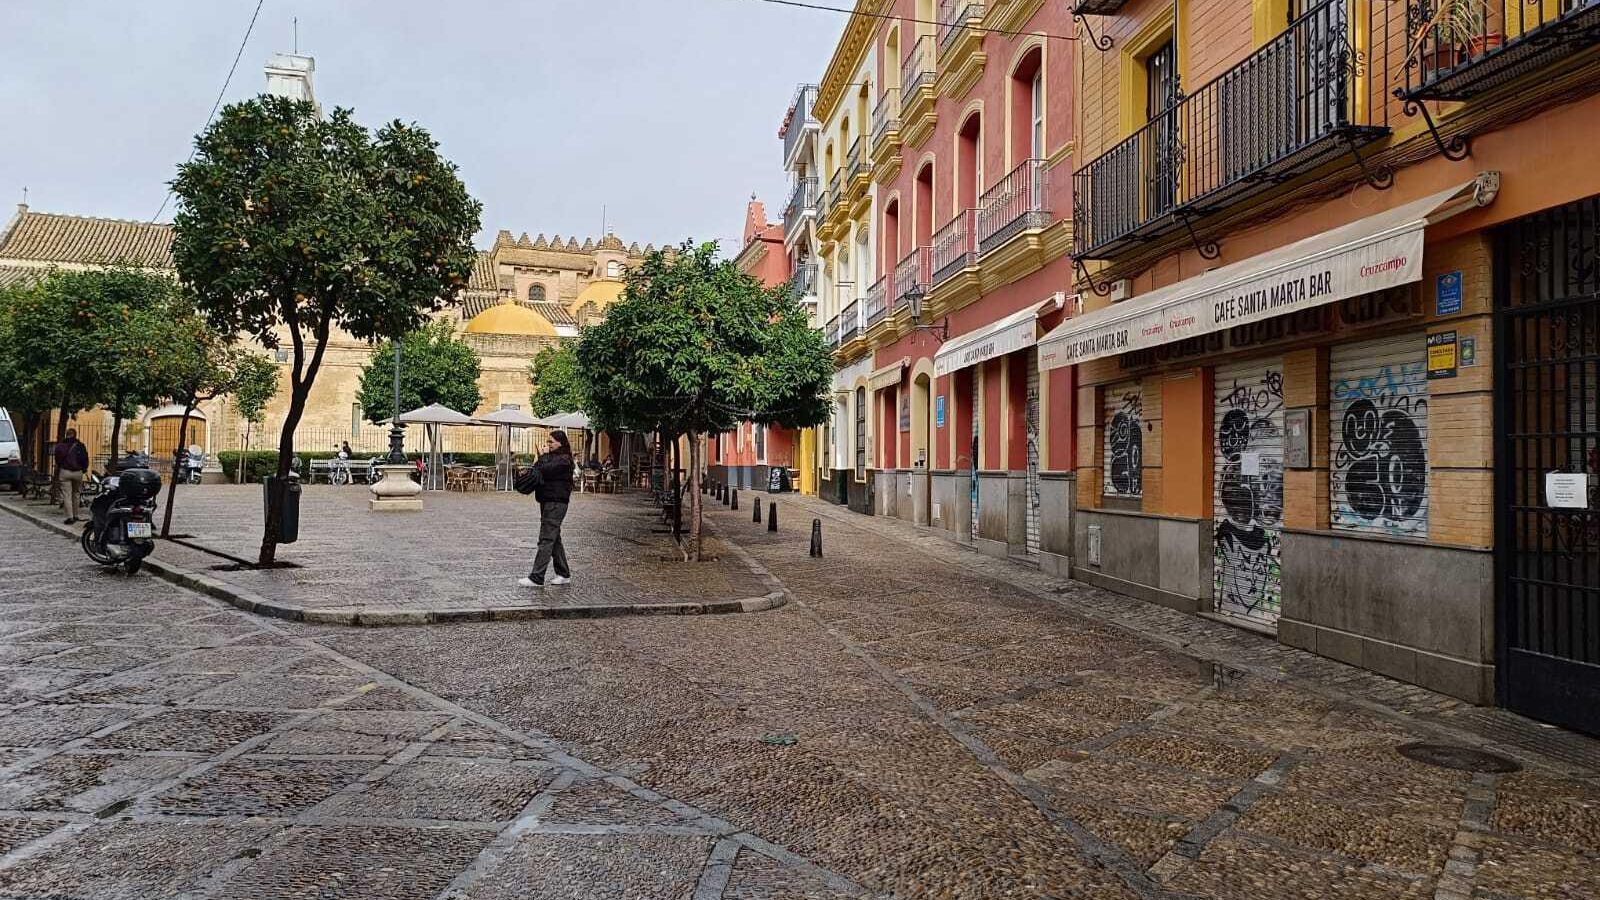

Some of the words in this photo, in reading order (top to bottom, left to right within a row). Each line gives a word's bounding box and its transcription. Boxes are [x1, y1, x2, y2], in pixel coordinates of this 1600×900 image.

[1360, 255, 1407, 277] Cruzcampo
[1214, 295, 1235, 323] CAFÉ
[1238, 289, 1267, 317] SANTA
[1270, 278, 1306, 308] MARTA
[1309, 270, 1332, 298] BAR
[1079, 338, 1096, 357] SANTA
[1096, 332, 1116, 352] MARTA
[1116, 329, 1129, 348] BAR
